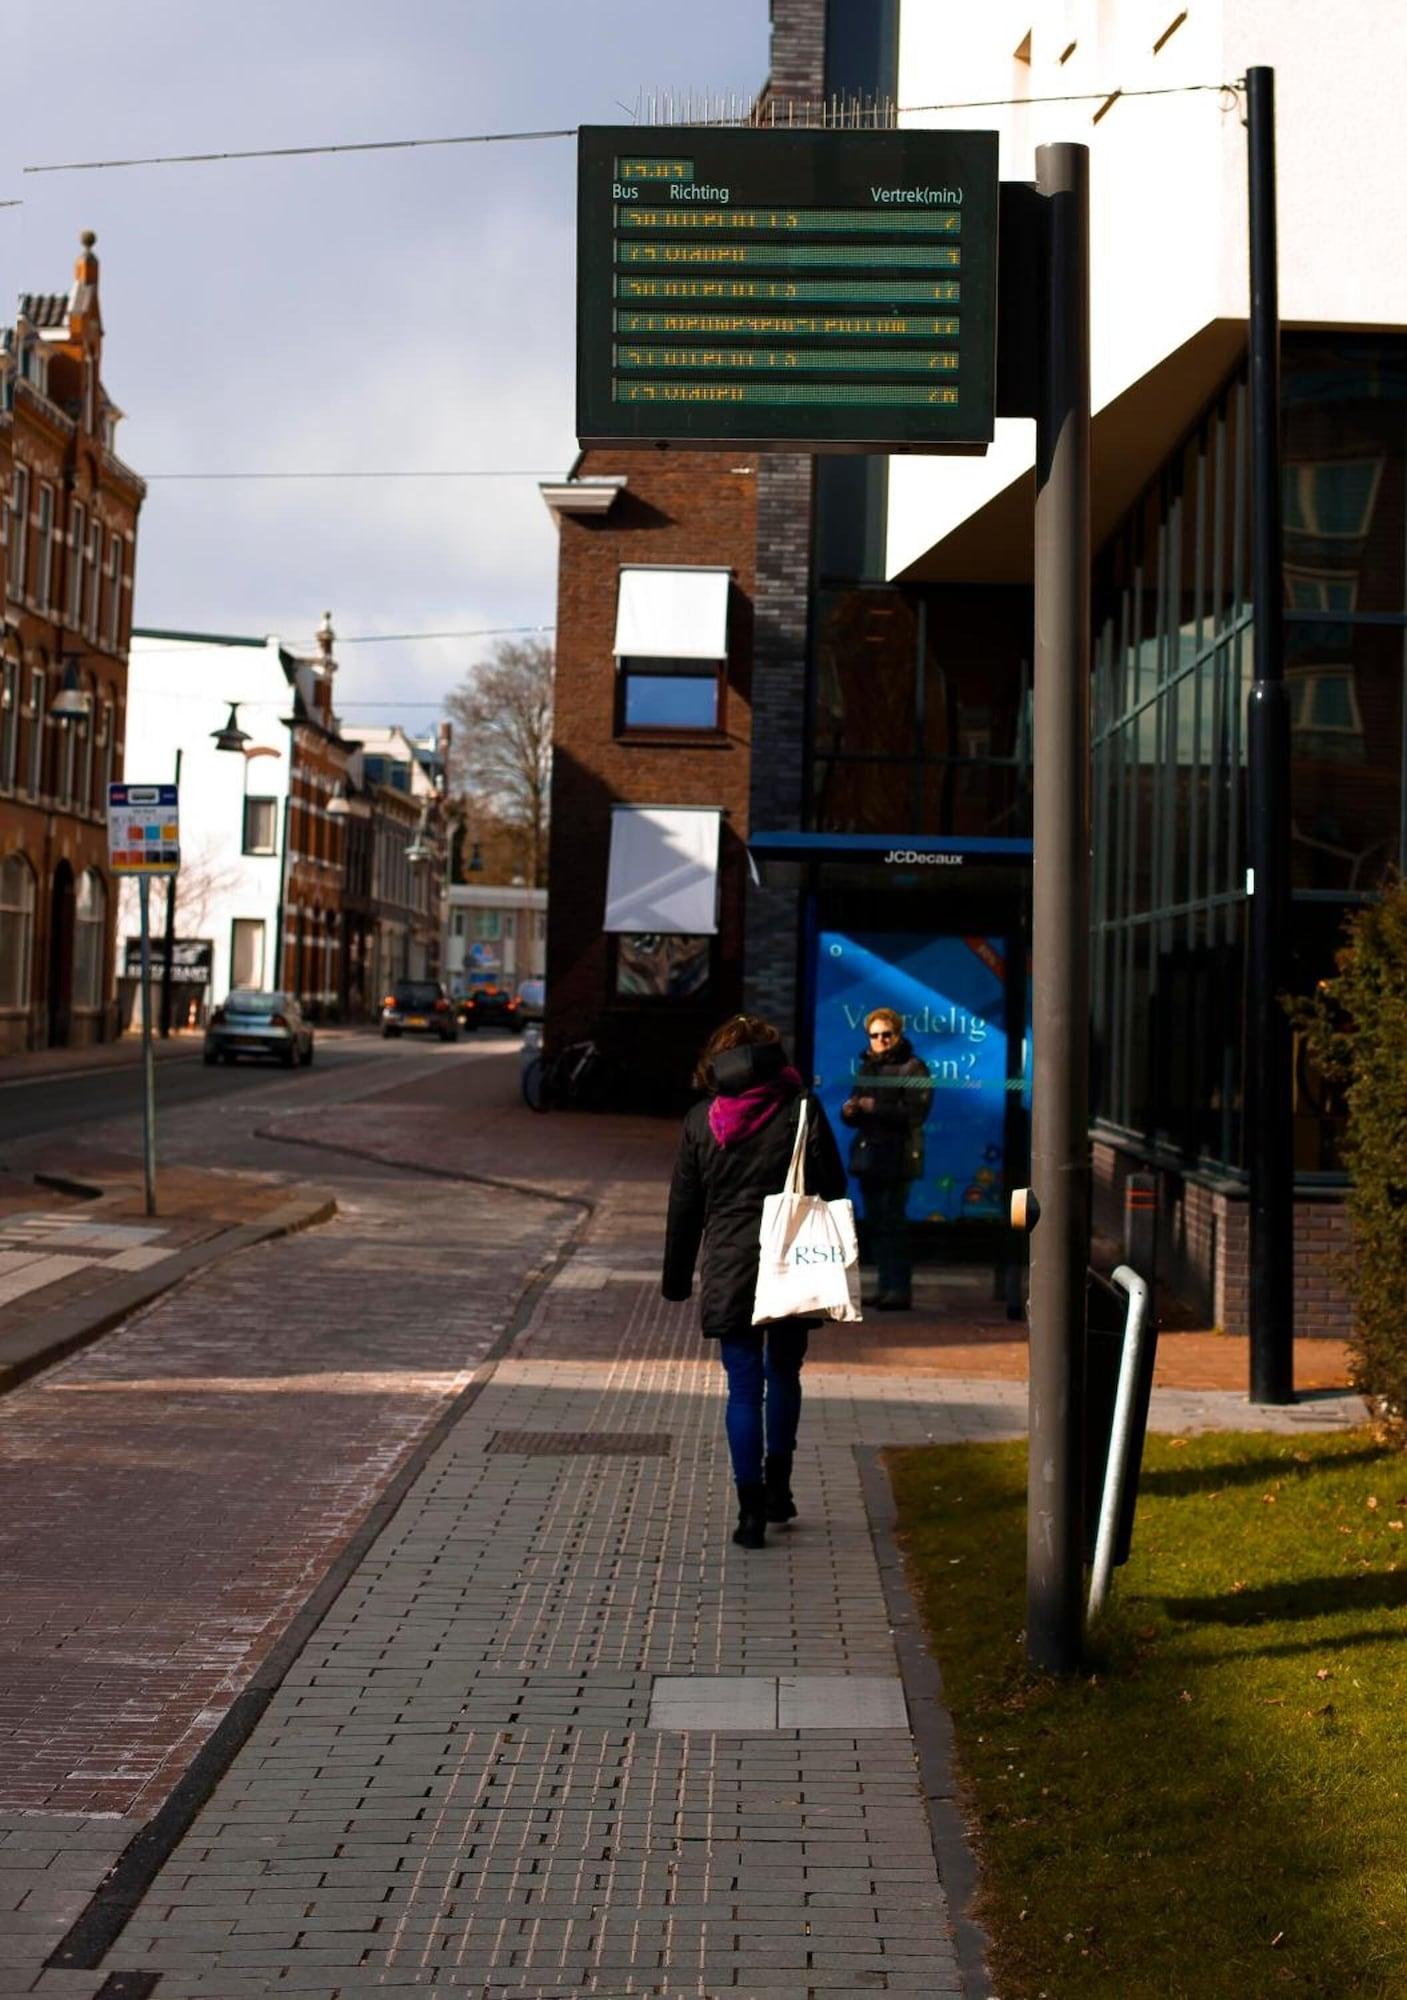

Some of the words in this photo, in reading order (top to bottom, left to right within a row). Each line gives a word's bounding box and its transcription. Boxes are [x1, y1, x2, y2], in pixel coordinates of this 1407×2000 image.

[612, 183, 639, 199] Bus
[670, 183, 730, 204] Richting
[870, 187, 963, 205] Vertrek(min.)
[884, 850, 963, 865] JCDecaux
[843, 1004, 988, 1043] Vrdelig
